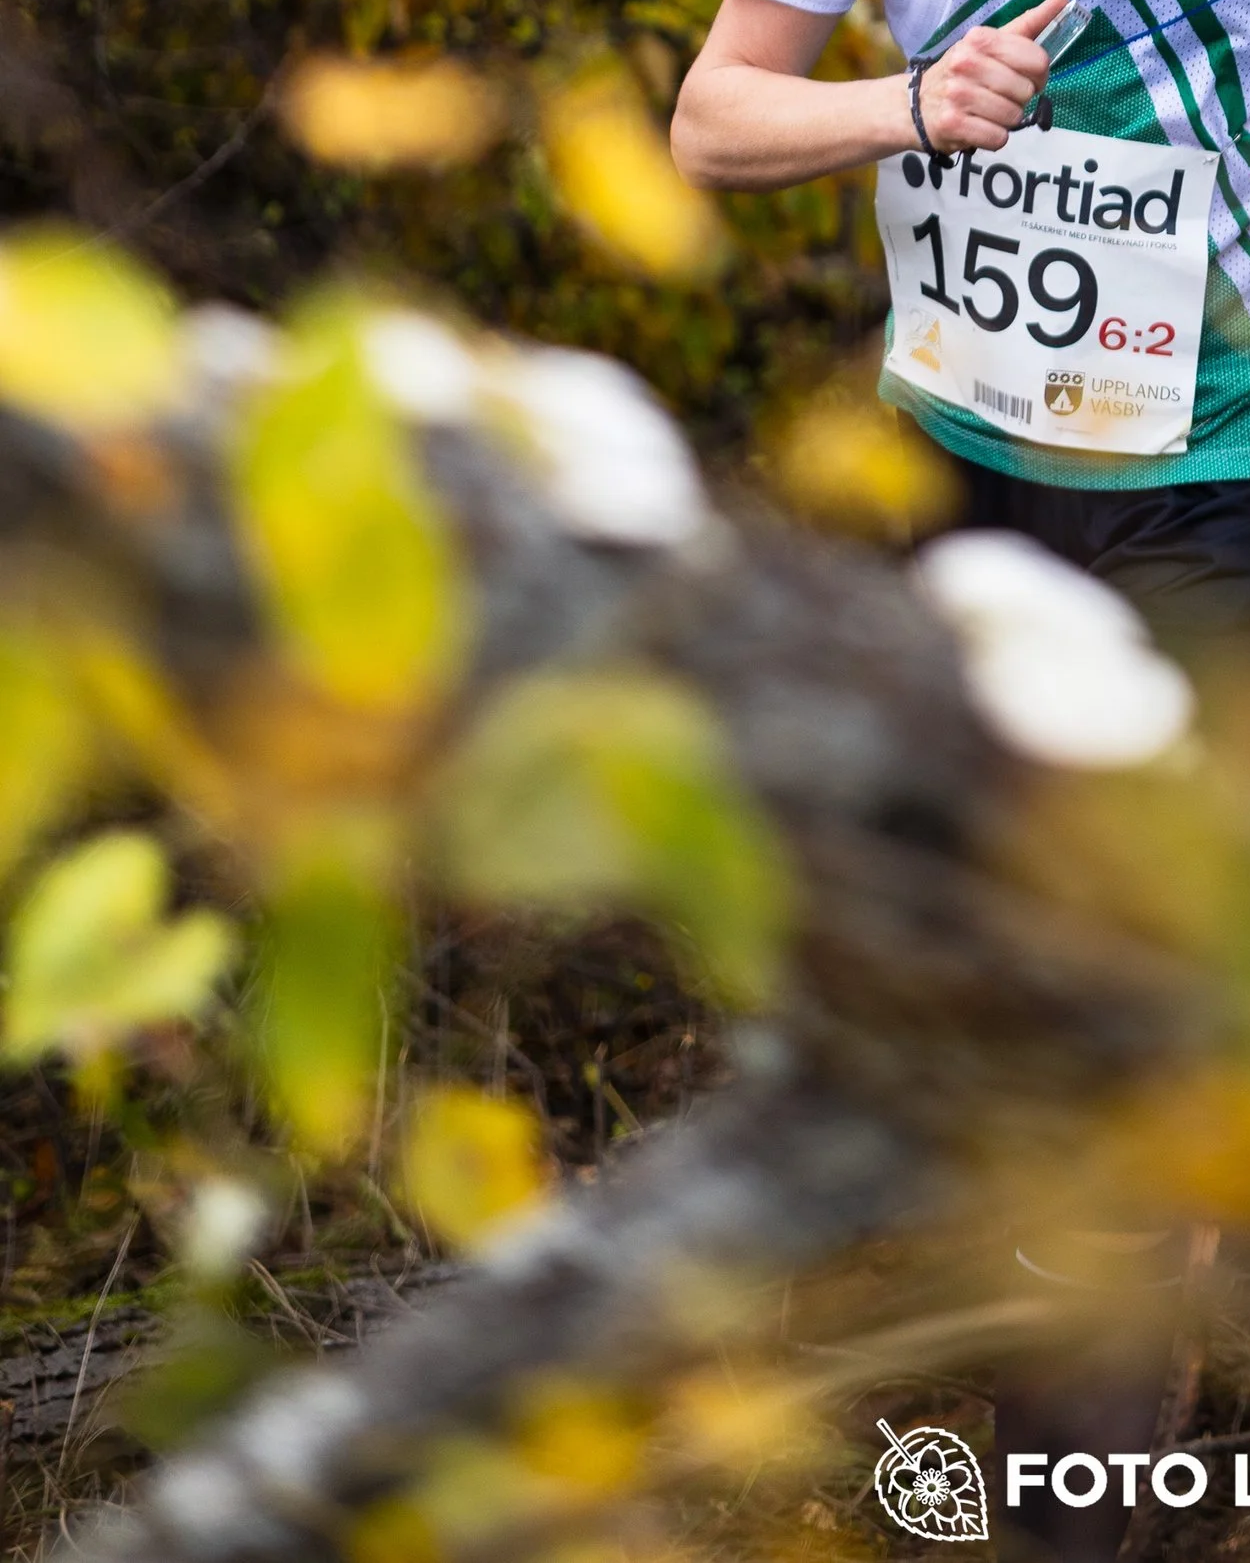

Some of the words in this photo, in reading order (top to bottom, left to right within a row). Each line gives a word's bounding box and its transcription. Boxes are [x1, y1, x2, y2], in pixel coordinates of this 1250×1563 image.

[959, 150, 1186, 236] fortiad
[1068, 230, 1087, 240] MED
[911, 212, 1099, 349] 159
[1098, 316, 1176, 357] 6:2
[1091, 377, 1181, 403] UPPLANDS
[1091, 396, 1145, 417] VÄSBY
